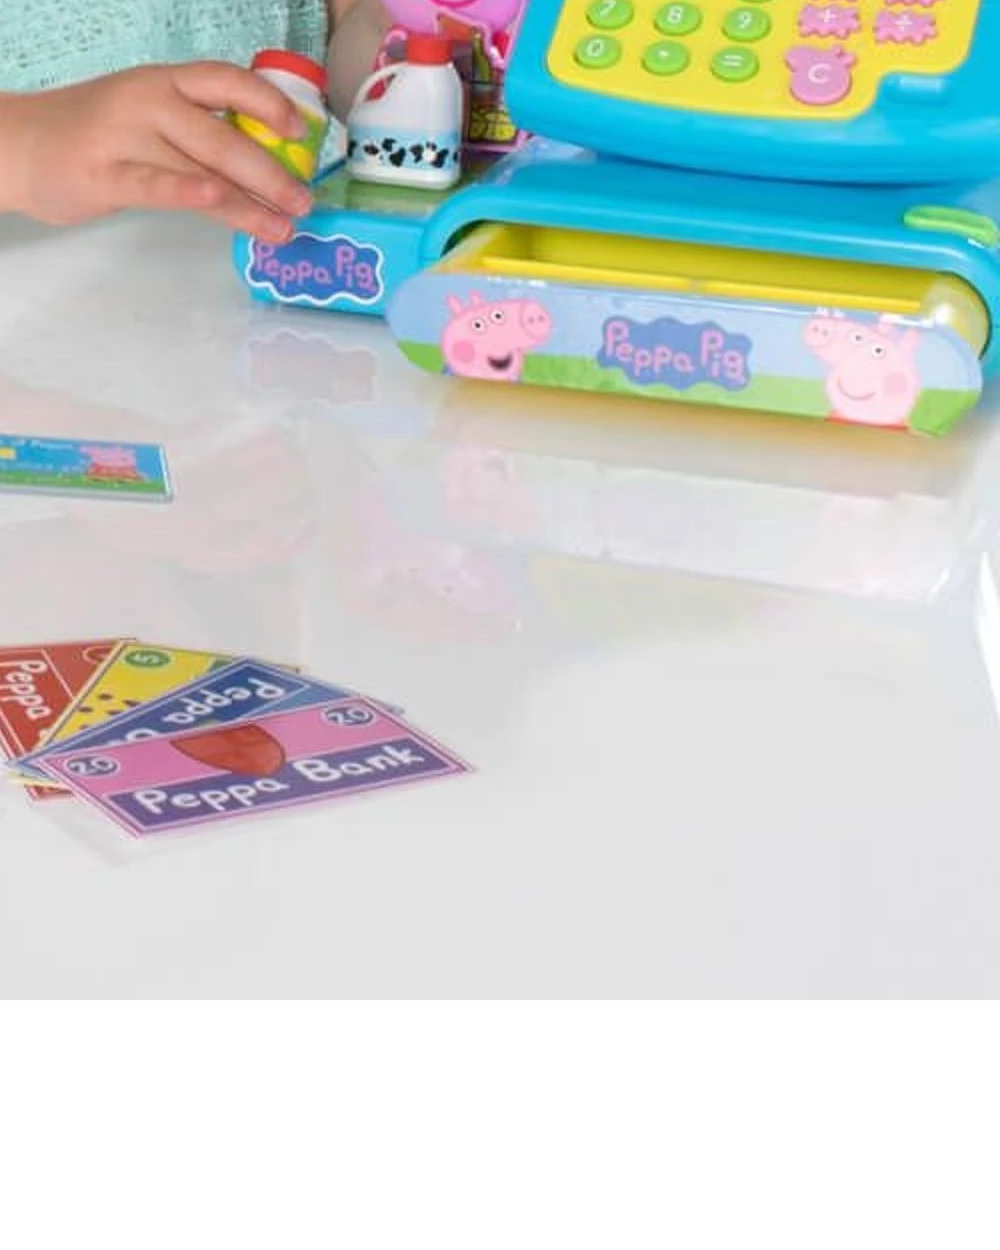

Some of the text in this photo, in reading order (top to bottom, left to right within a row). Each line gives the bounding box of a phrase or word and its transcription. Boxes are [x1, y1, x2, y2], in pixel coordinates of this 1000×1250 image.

[667, 6, 684, 24] 8
[738, 12, 752, 30] 9
[586, 38, 605, 58] 0
[807, 63, 832, 84] C
[255, 242, 378, 294] Peppa Pig
[605, 319, 746, 386] Peppa Pig
[161, 677, 285, 724] Peppa
[330, 707, 371, 727] 20
[68, 756, 114, 774] 20
[132, 743, 425, 817] Peppa Bank
